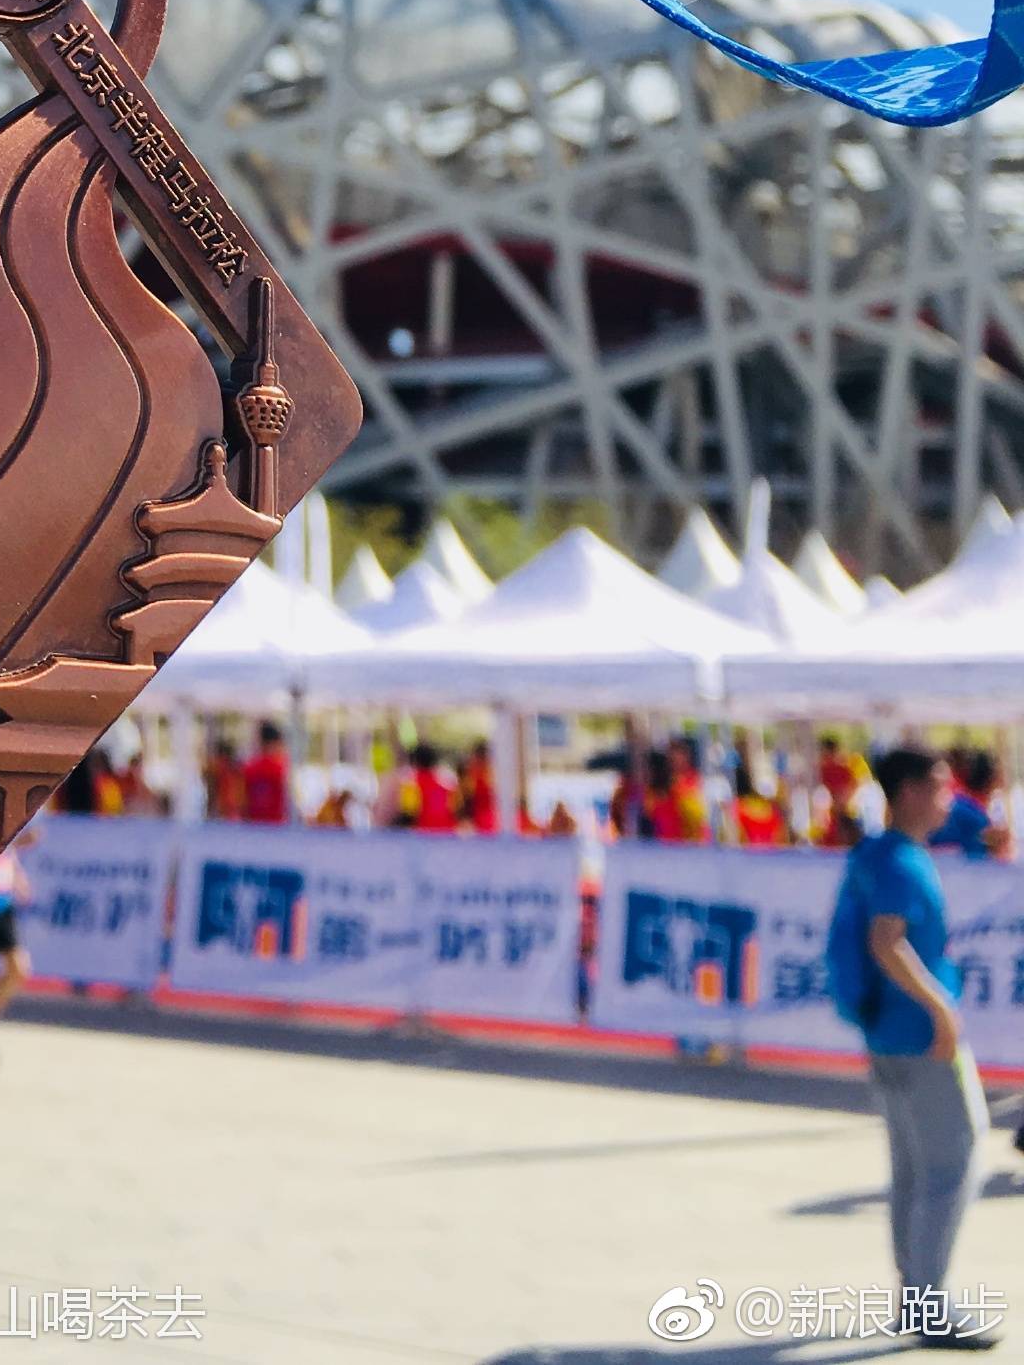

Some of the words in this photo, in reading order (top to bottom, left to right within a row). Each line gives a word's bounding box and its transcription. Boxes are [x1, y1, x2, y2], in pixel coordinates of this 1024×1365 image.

[52, 22, 248, 288] 北京半程马拉松
